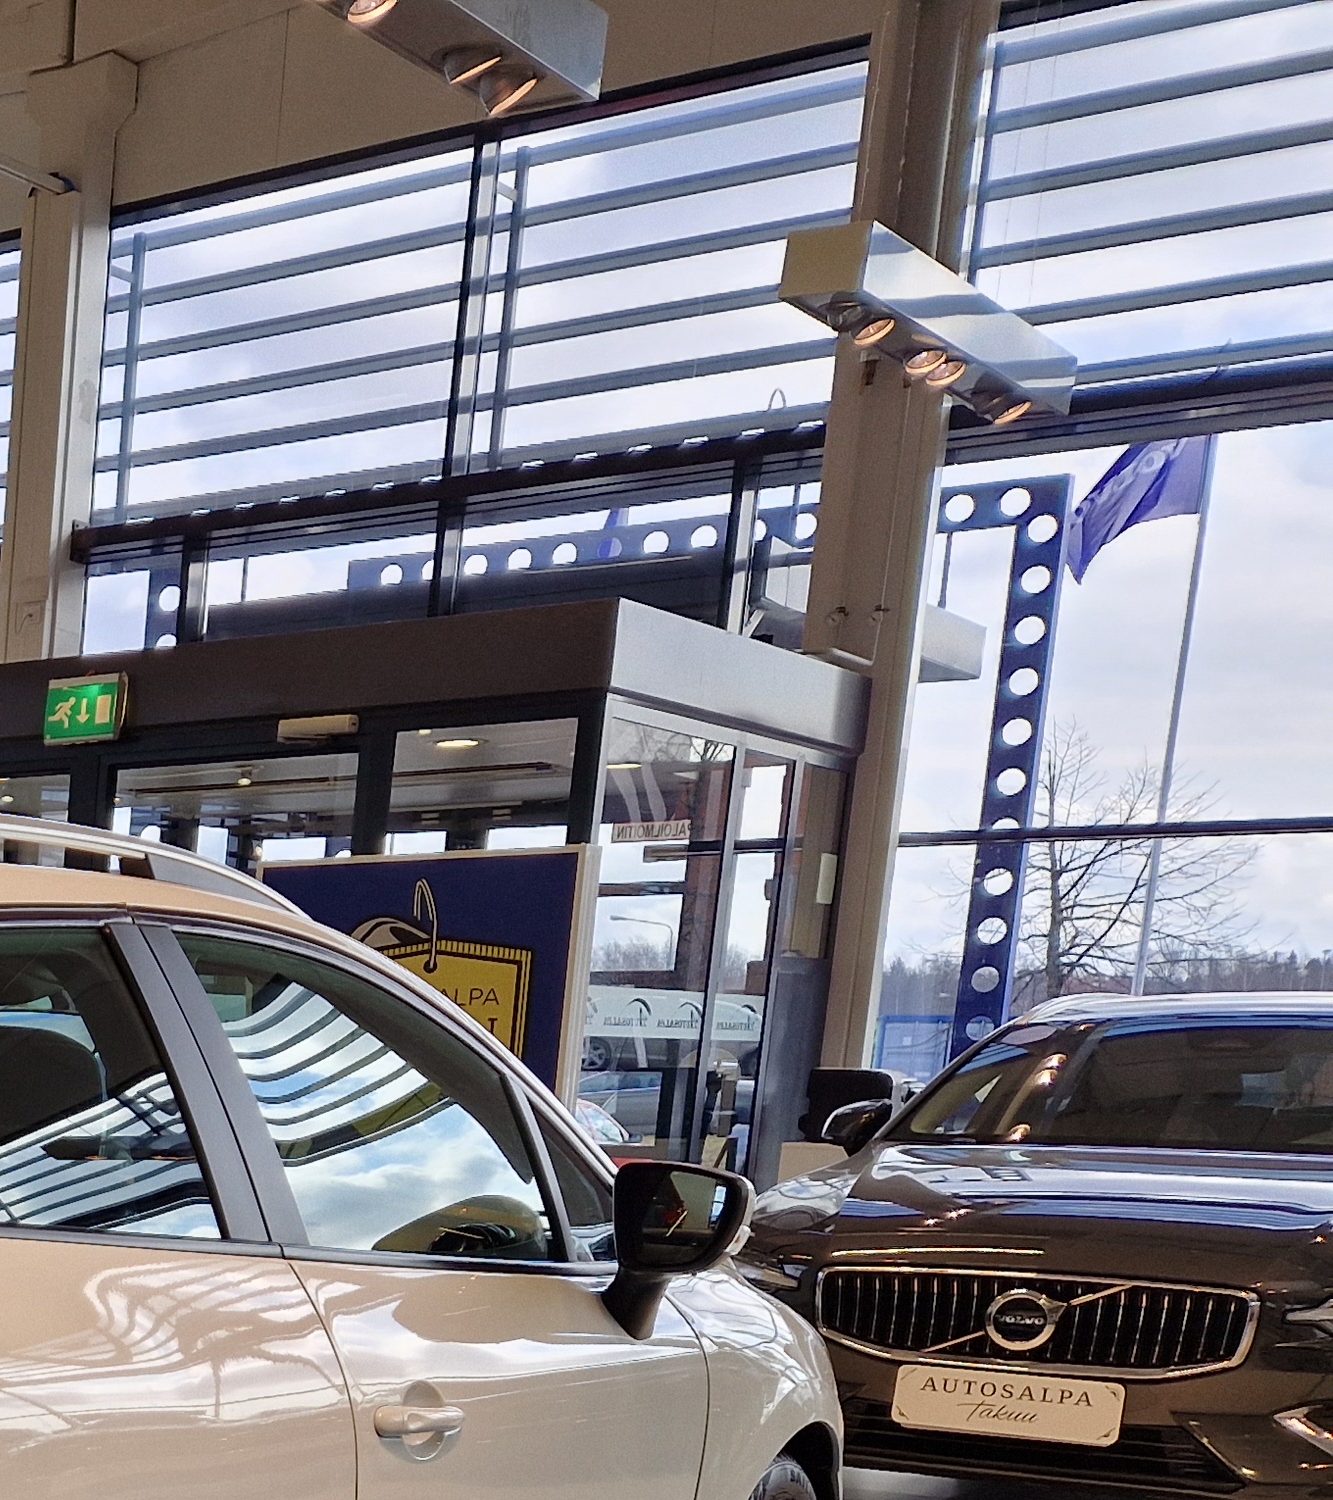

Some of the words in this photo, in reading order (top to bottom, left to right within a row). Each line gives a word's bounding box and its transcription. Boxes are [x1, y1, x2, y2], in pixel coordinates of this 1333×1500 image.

[995, 1314, 1045, 1326] VOLVO
[920, 1376, 1093, 1407] AUTOSALPA
[957, 1399, 1039, 1423] Takuu
